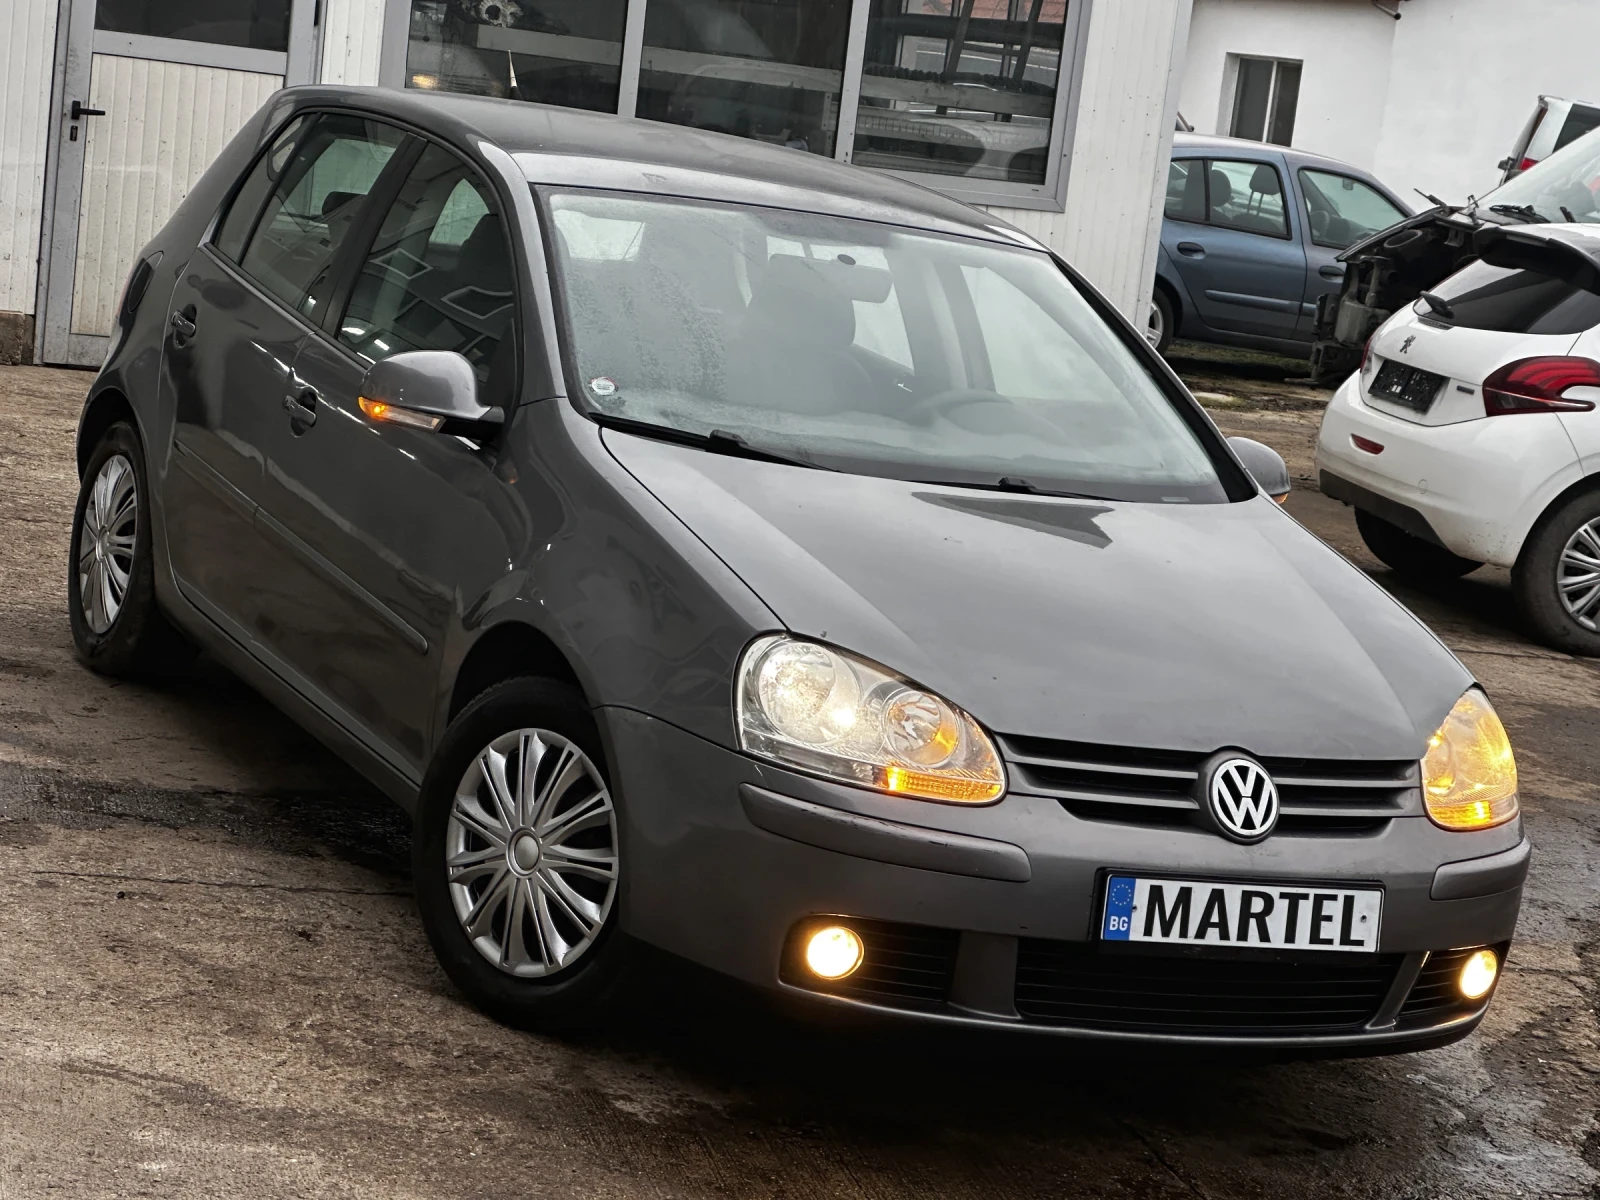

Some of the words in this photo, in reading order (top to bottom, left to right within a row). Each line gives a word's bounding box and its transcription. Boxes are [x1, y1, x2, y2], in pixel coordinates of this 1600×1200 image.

[1213, 759, 1278, 836] VW
[1109, 915, 1129, 932] BG
[1142, 884, 1365, 947] MARTEL
